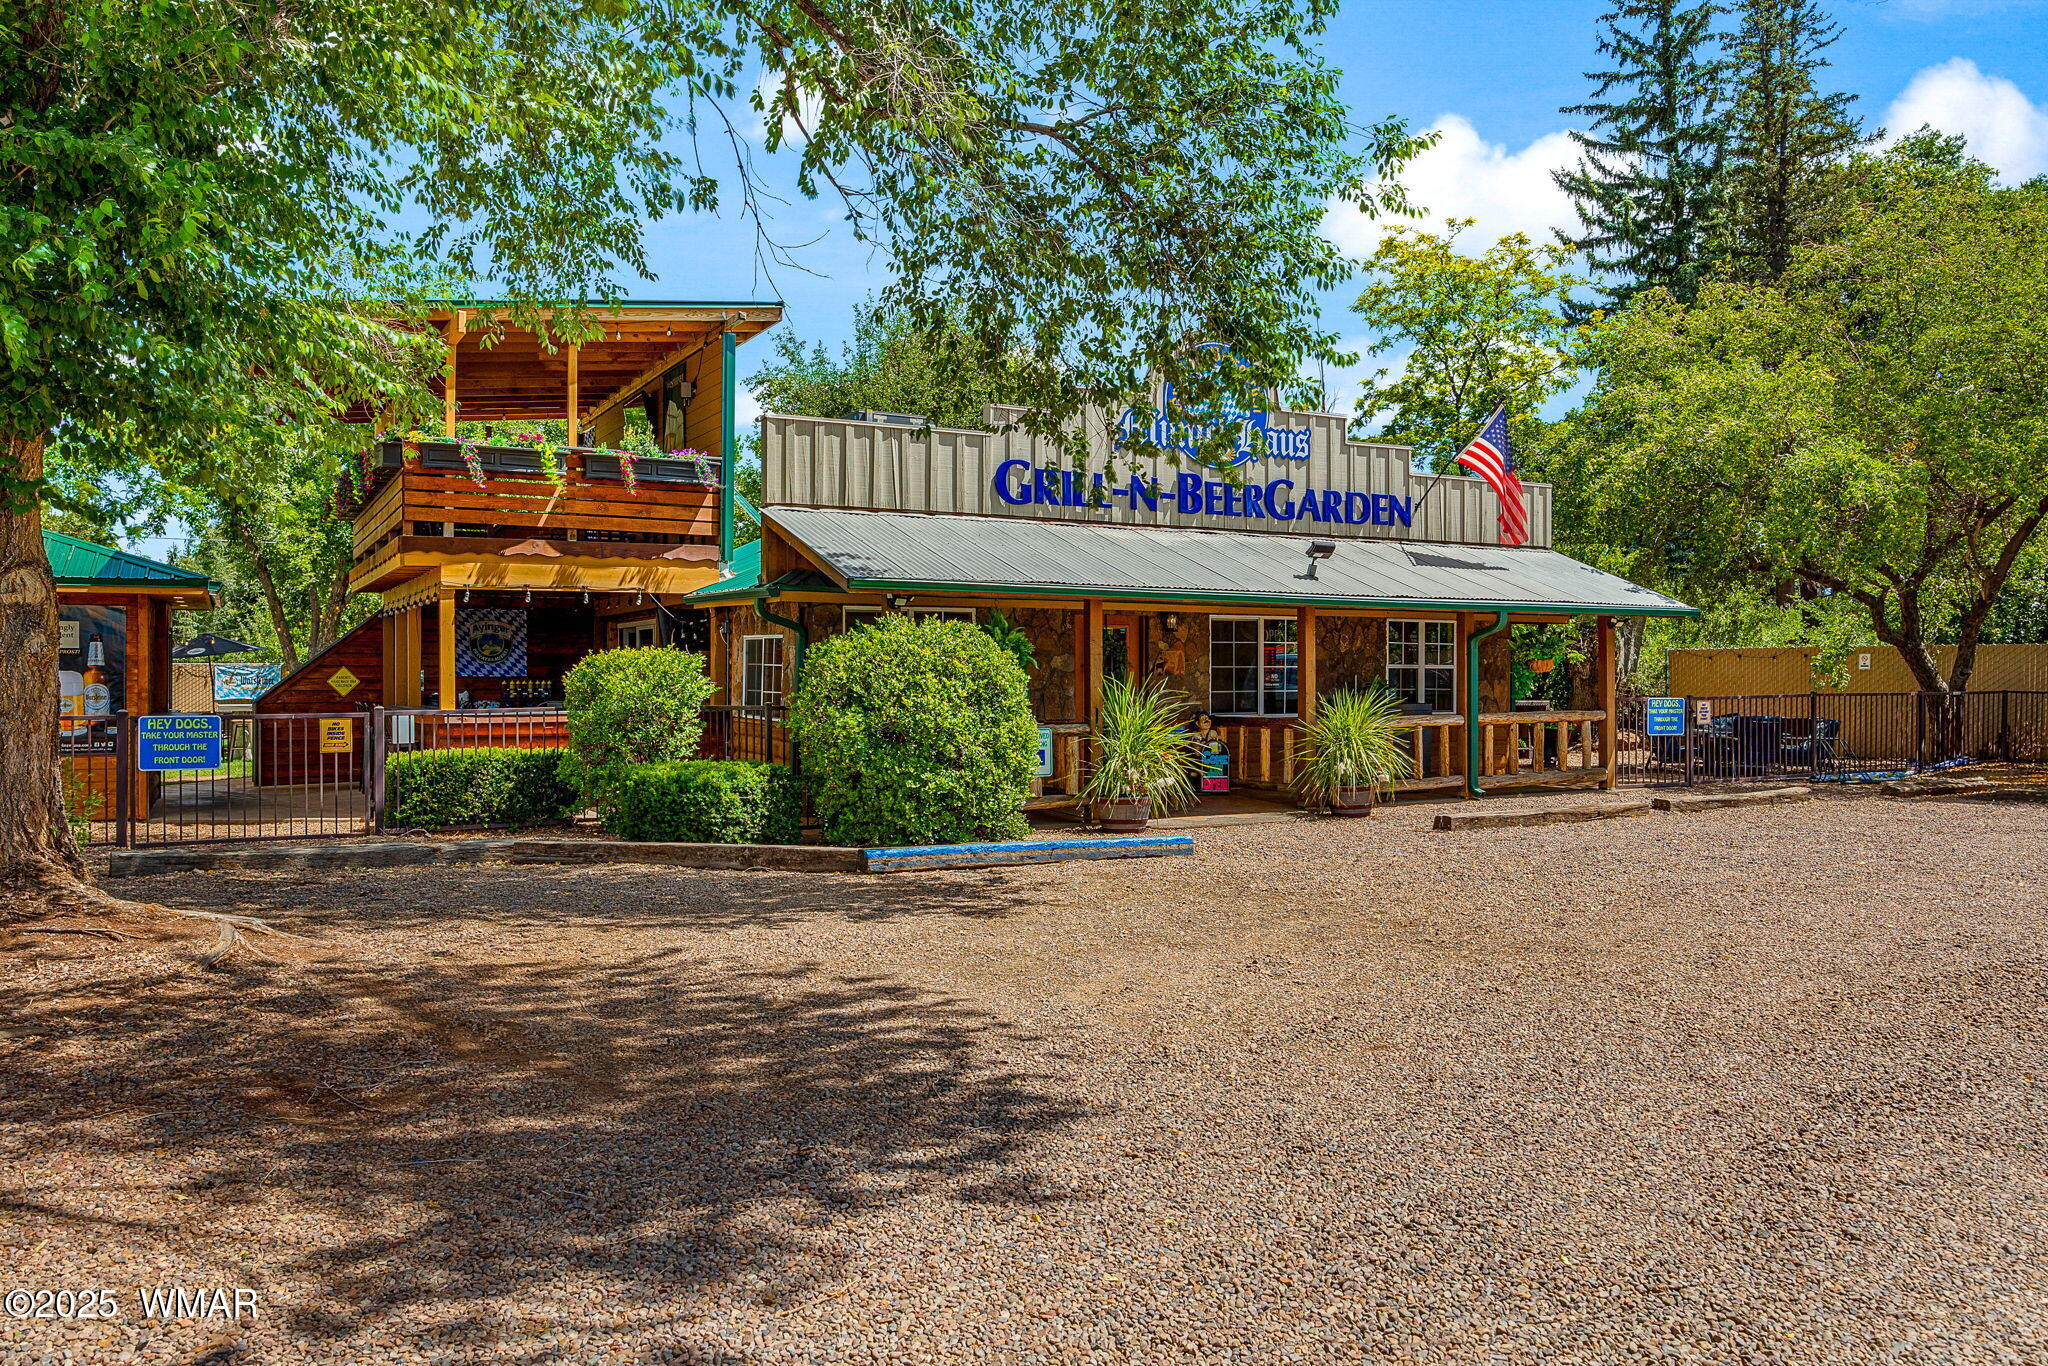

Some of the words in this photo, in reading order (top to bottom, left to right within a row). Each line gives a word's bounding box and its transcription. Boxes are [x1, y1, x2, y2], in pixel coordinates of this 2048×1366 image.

[147, 718, 172, 730] HEY
[175, 718, 212, 729] DOGS.
[141, 731, 162, 739] TAKE
[163, 731, 185, 739] YOUR
[186, 731, 219, 739] MASTER
[152, 743, 191, 751] THROUGH
[192, 743, 208, 751] THE
[153, 756, 180, 764] FRONT
[181, 756, 206, 764] DOOR!
